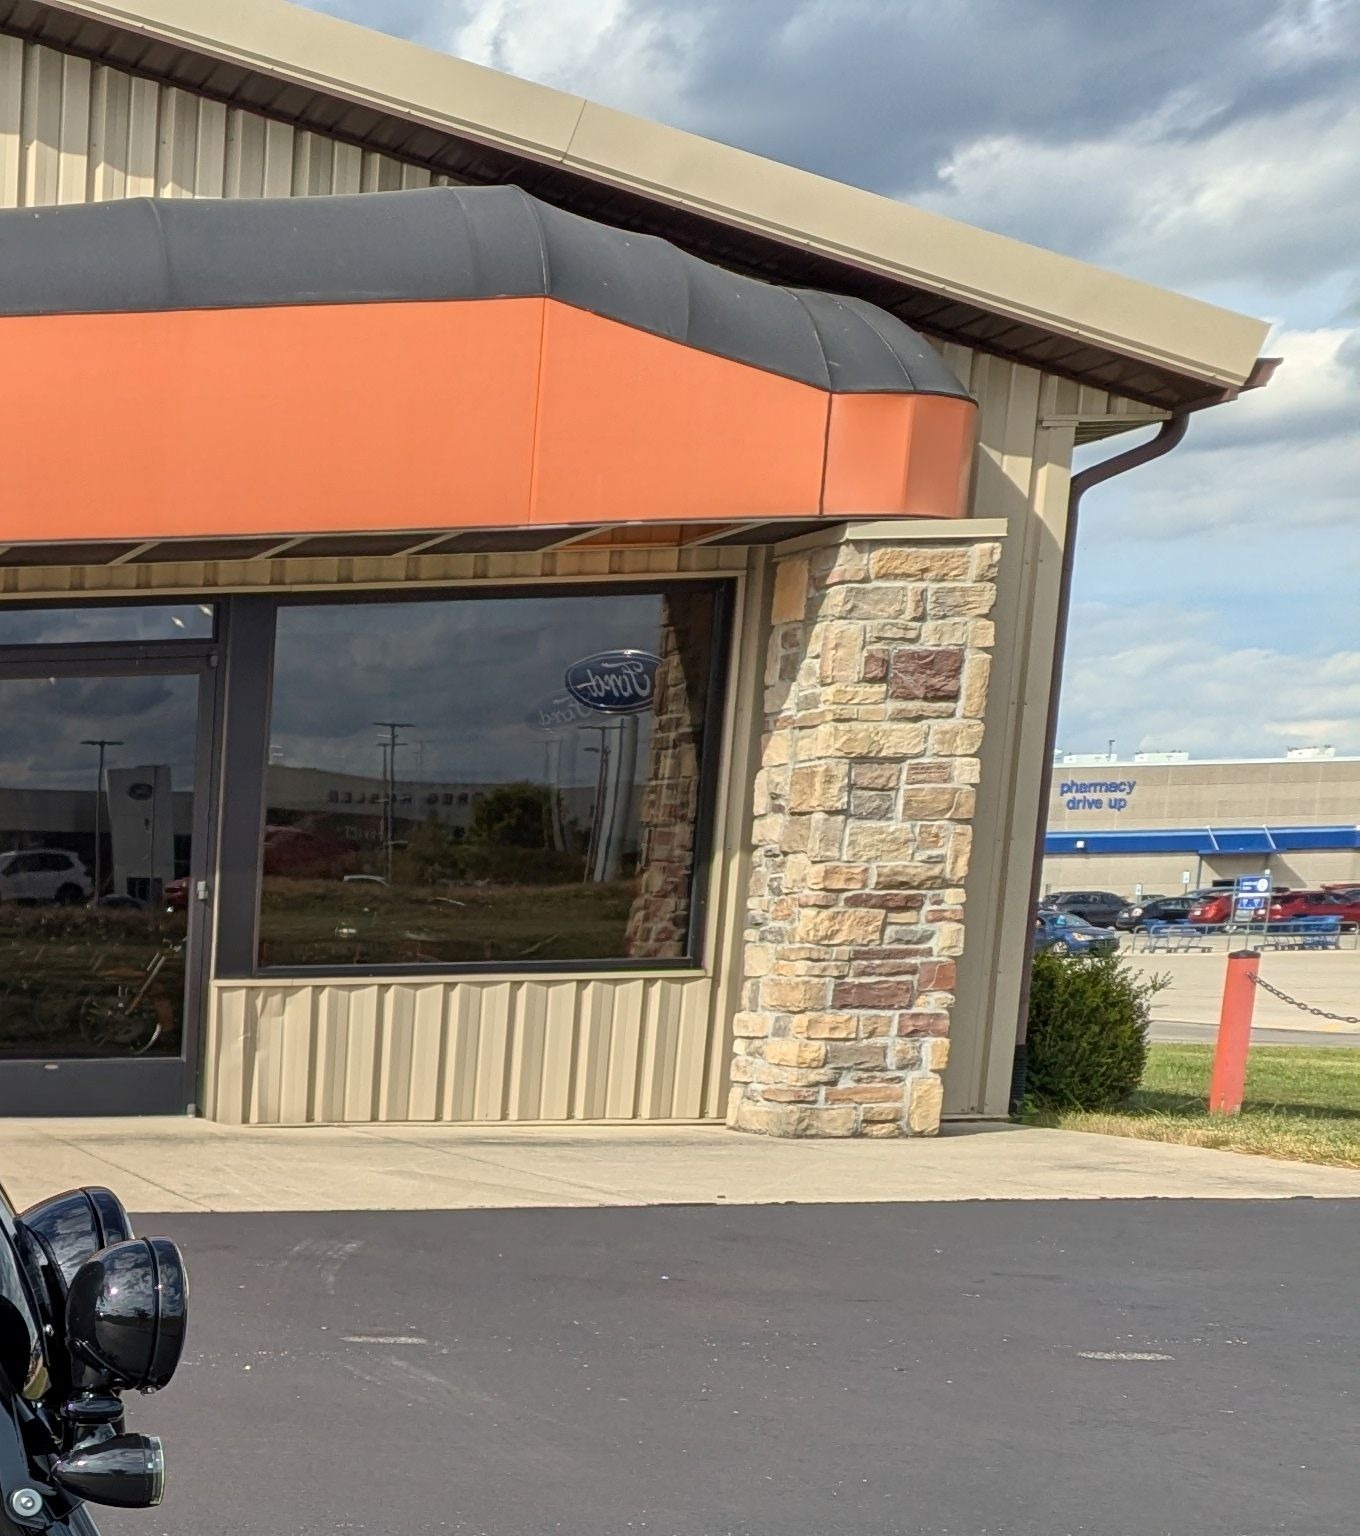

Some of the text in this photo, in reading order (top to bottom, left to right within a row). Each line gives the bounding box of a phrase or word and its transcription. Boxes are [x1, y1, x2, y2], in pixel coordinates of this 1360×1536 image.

[1059, 779, 1137, 797] pharmacy
[1066, 795, 1128, 811] drive up
